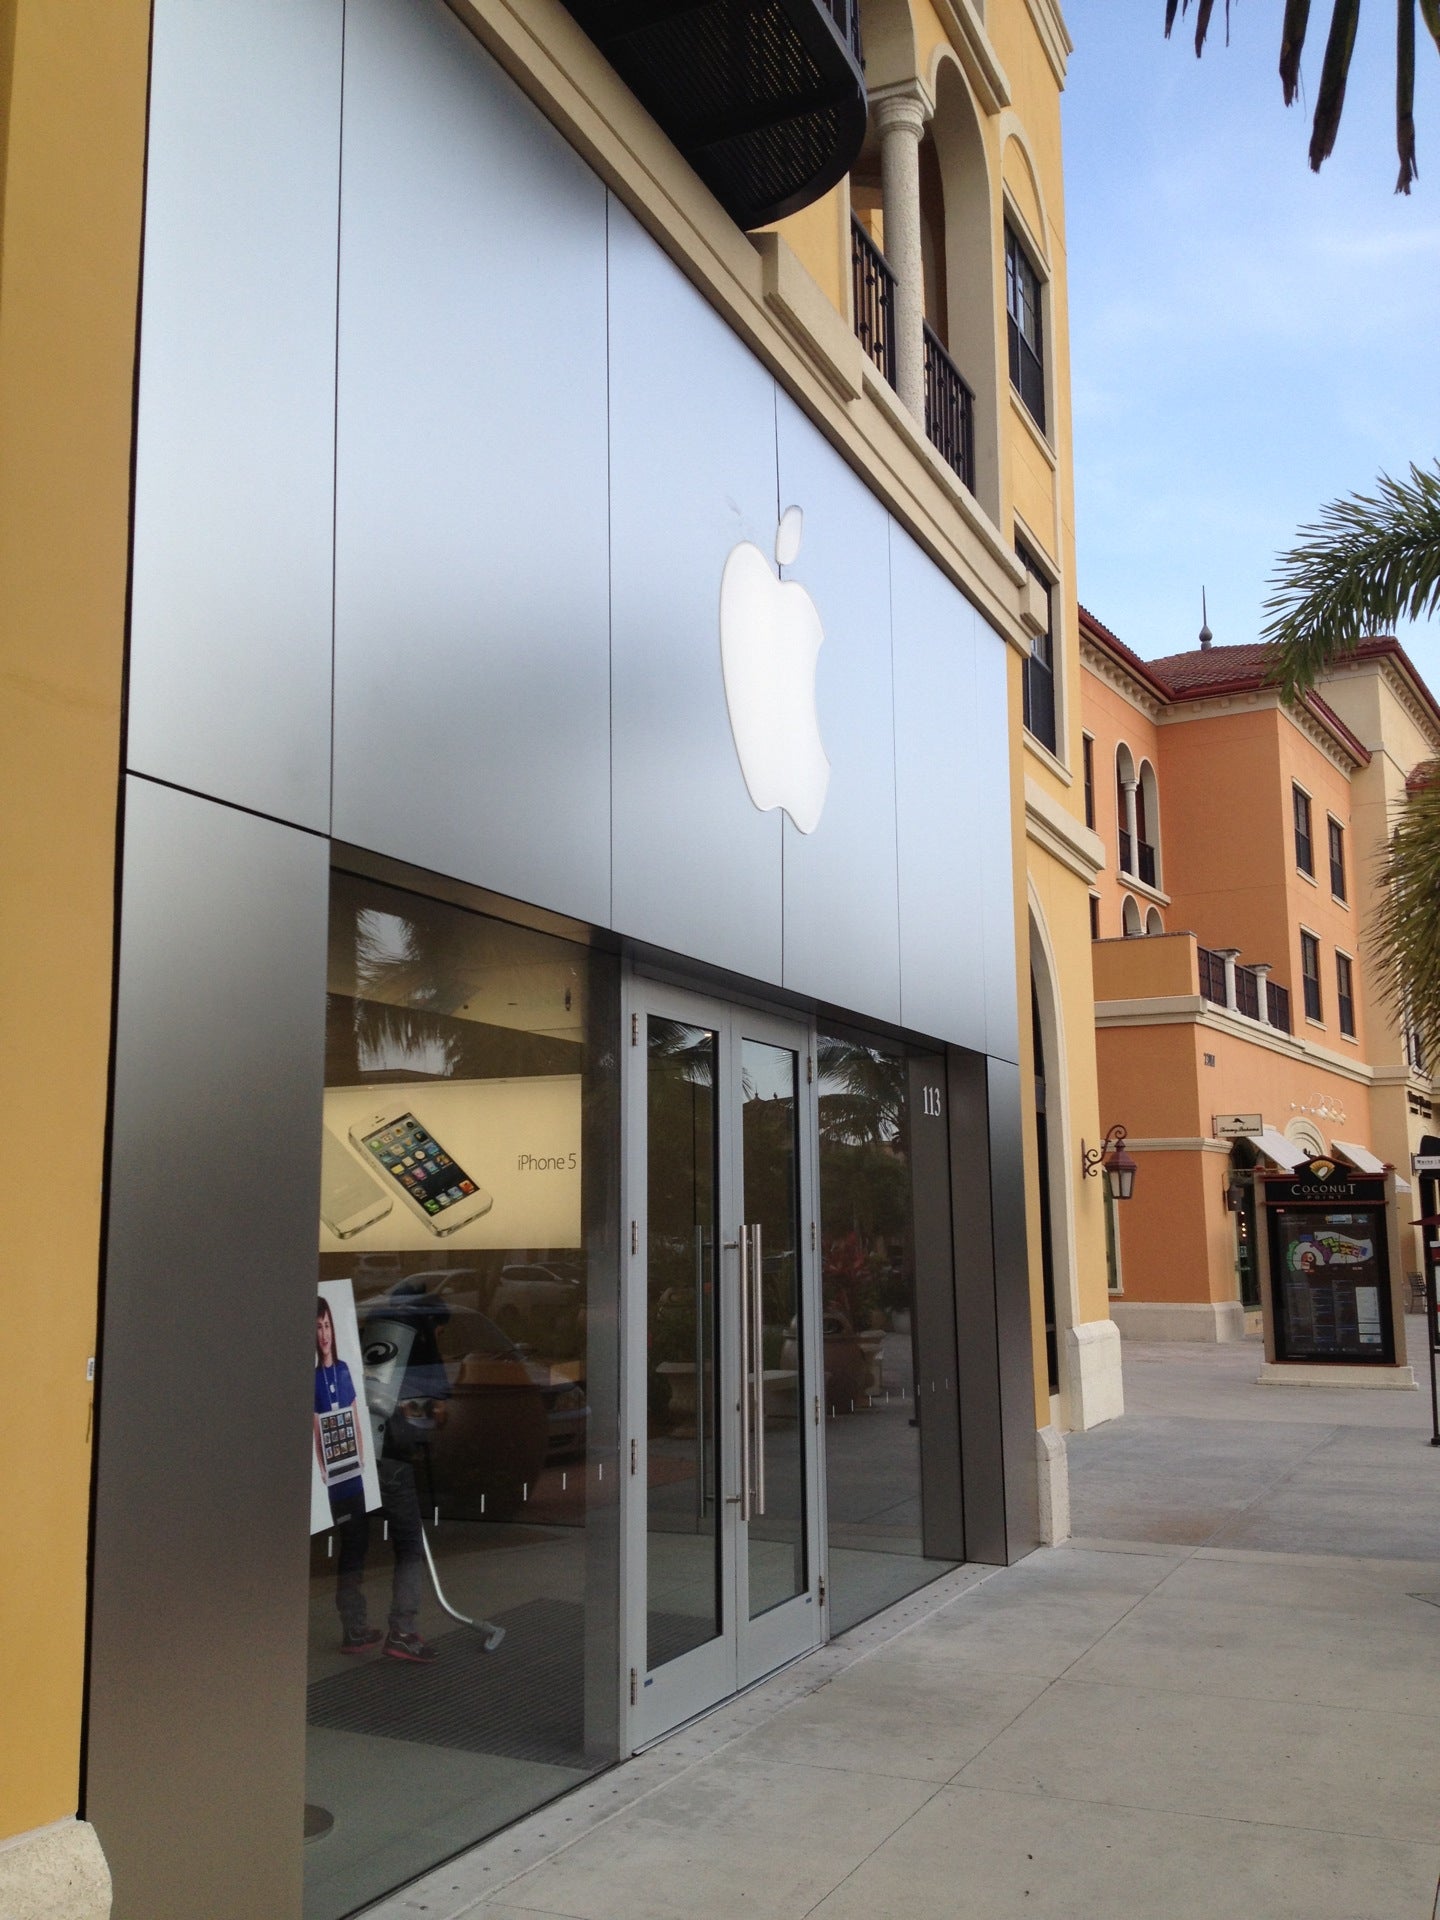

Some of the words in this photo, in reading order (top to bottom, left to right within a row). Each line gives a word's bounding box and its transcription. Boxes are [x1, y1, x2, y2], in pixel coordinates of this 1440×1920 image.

[922, 1085, 941, 1117] 113
[518, 1154, 565, 1170] iPhone
[567, 1152, 577, 1170] 5
[1291, 1183, 1356, 1196] COCONUT
